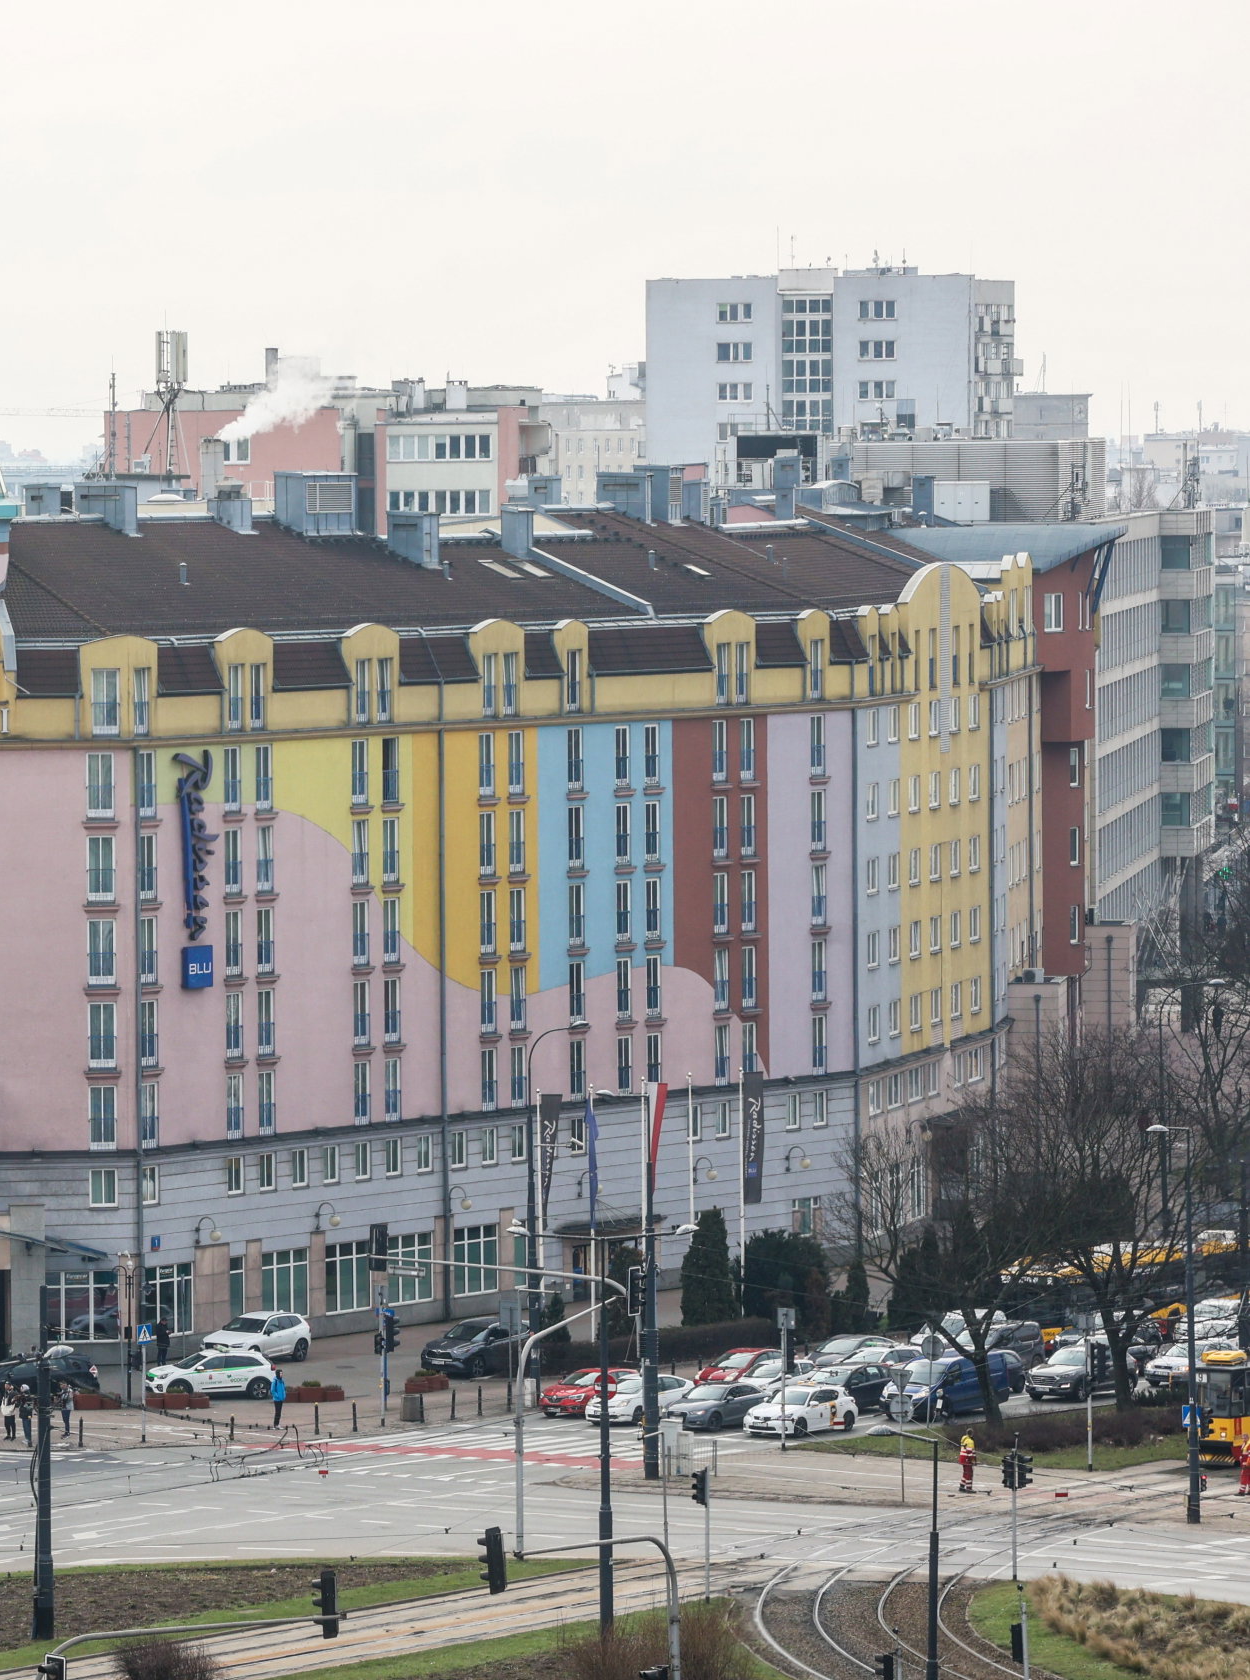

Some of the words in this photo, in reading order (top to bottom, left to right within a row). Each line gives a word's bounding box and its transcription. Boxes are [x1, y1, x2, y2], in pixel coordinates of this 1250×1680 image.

[172, 749, 220, 941] Radisson
[189, 962, 212, 975] BLU
[748, 1096, 762, 1162] Radisson
[1198, 1373, 1204, 1382] 9
